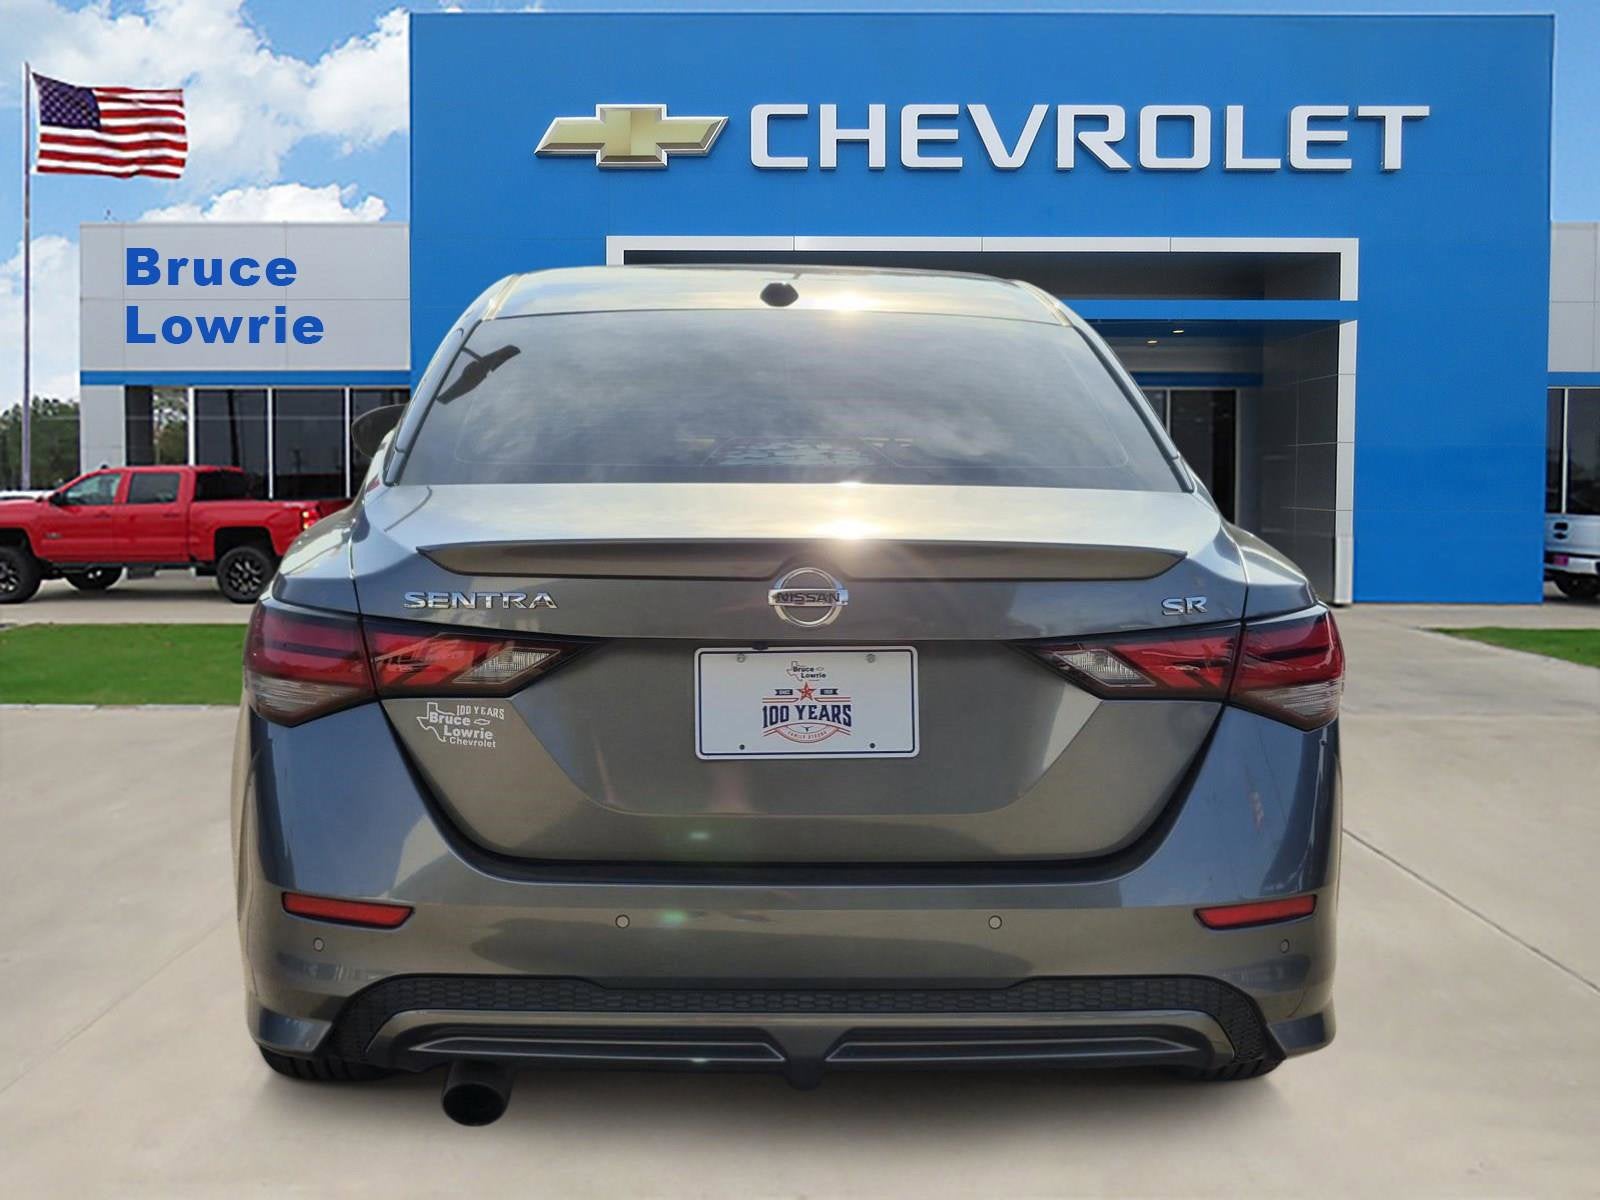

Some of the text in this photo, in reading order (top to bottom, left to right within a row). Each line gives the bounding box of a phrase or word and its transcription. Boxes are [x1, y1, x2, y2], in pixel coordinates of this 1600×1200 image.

[750, 103, 1431, 172] CHEVROLET
[126, 248, 297, 286] Bruce
[126, 306, 324, 344] Lowrie
[403, 591, 558, 610] SENTRA
[775, 592, 840, 603] NISSAN
[1161, 596, 1208, 616] SR
[429, 711, 471, 726] Bruce
[456, 704, 505, 720] 100 YEARS
[763, 705, 852, 728] 100 YEARS
[443, 725, 494, 740] Lowrie
[449, 736, 496, 748] Chevrolet
